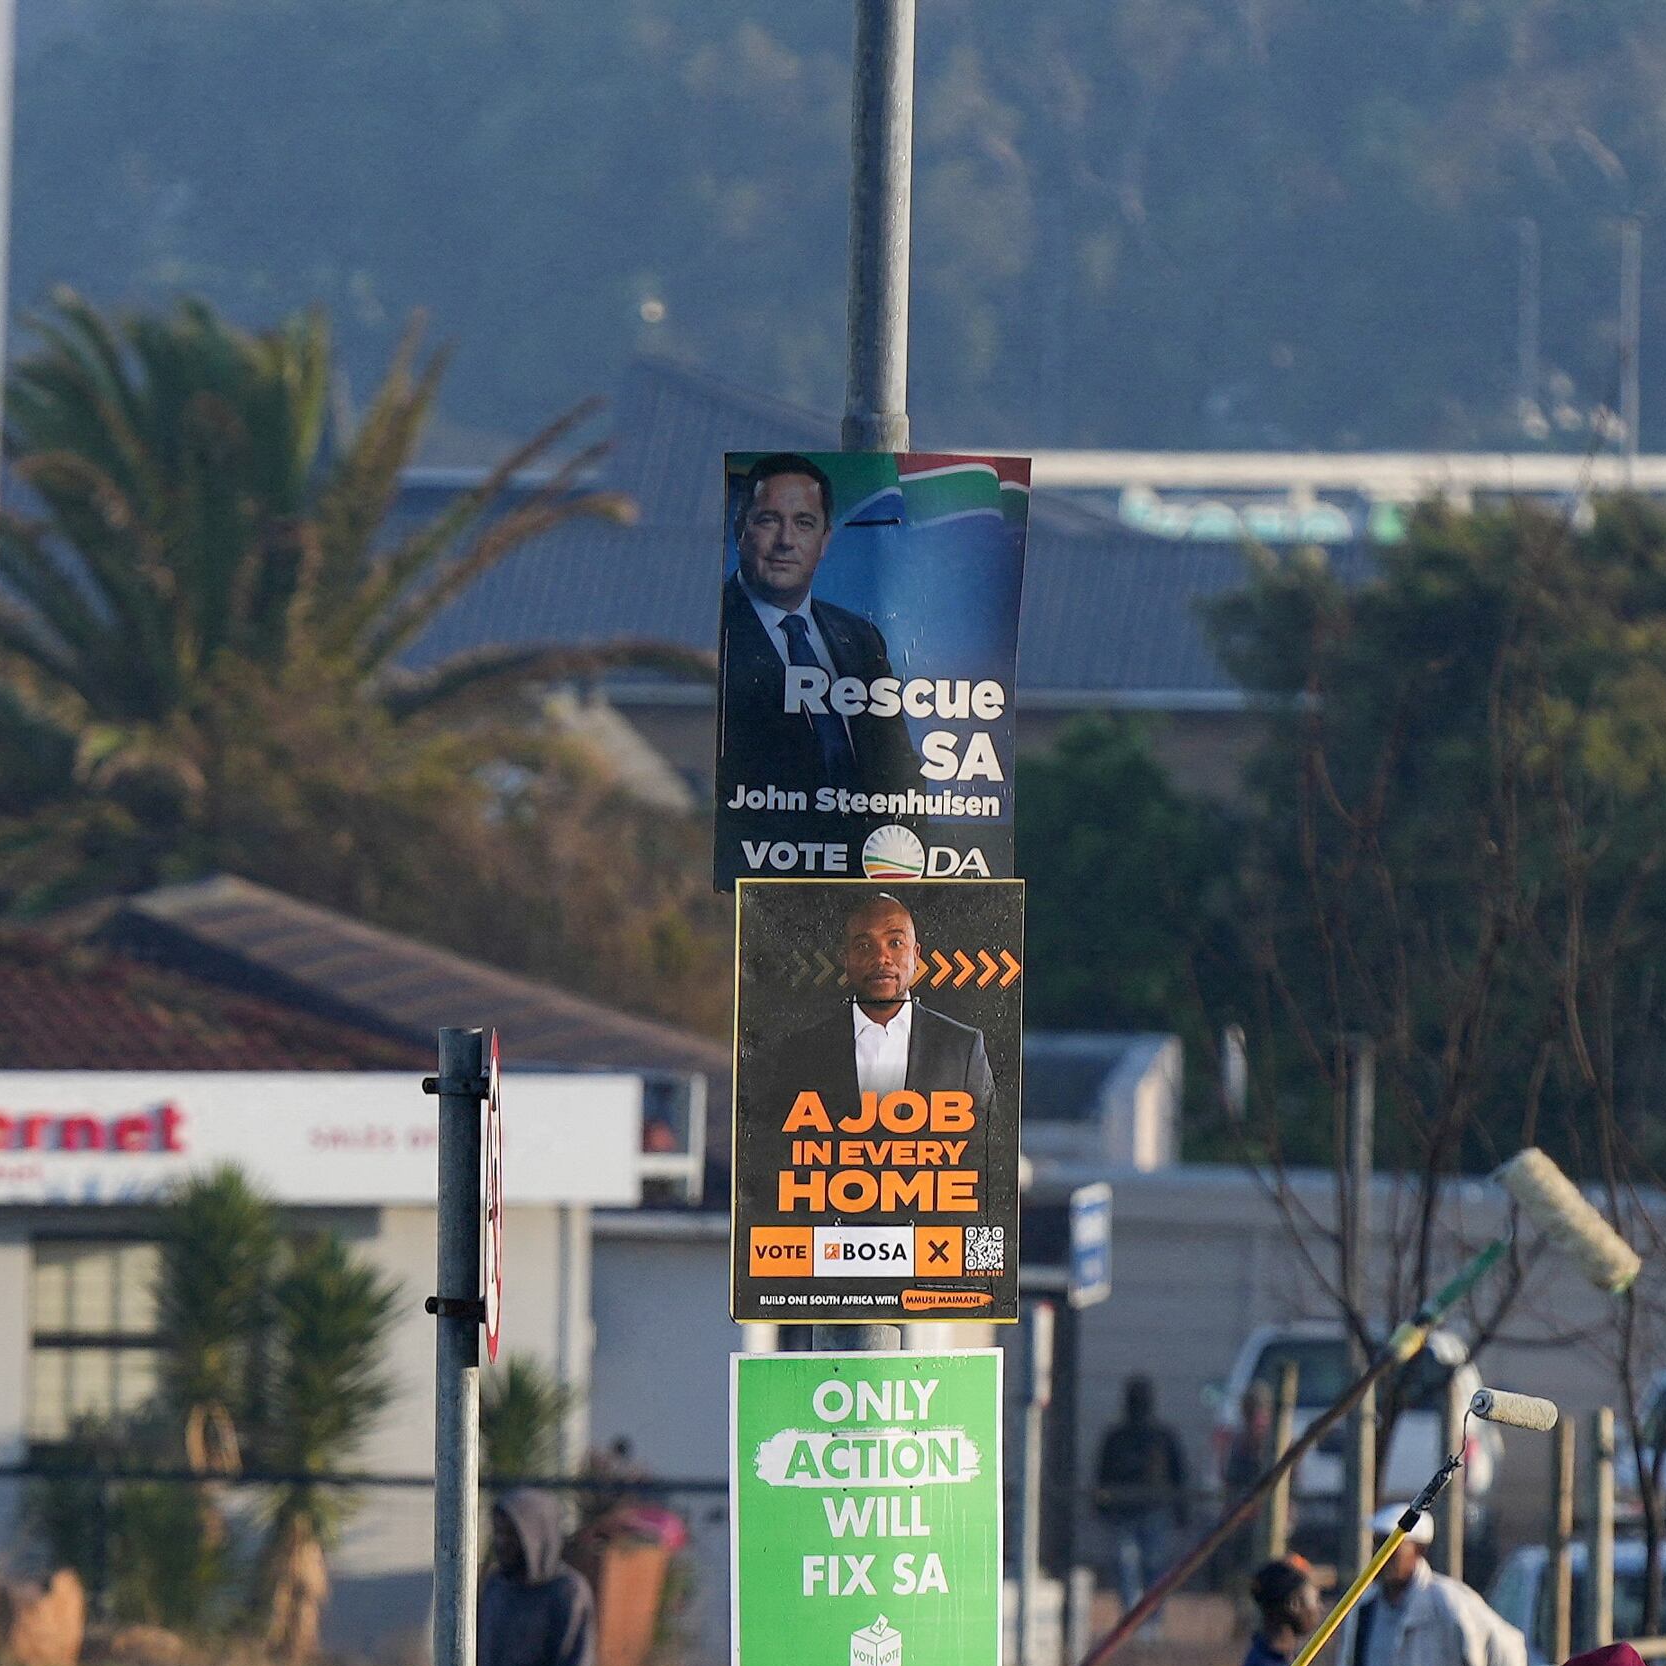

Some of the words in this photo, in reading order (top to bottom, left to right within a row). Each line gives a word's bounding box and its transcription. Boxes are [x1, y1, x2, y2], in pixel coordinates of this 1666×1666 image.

[784, 665, 1005, 720] Rescue
[920, 731, 1004, 782] SA
[727, 784, 807, 811] John
[814, 787, 1000, 817] Steenhuisen
[741, 840, 848, 871] VOTE
[927, 846, 991, 877] DA
[781, 1091, 833, 1132] A
[837, 1090, 976, 1133] JOB
[792, 1140, 832, 1165] IN
[839, 1140, 968, 1165] EVERY
[778, 1170, 979, 1213] HOME
[755, 1245, 807, 1259] VOTE
[843, 1243, 908, 1261] BOSA
[760, 1296, 786, 1305] BUILD
[788, 1296, 808, 1305] ONE
[809, 1295, 840, 1305] SOUTH
[842, 1295, 874, 1305] AFRICA
[875, 1295, 899, 1305] WITH
[938, 1296, 981, 1304] MAIMANE
[813, 1379, 939, 1422] ONLY
[785, 1438, 960, 1480] ACTION
[823, 1496, 931, 1537] WILL
[803, 1554, 878, 1596] FIX
[893, 1553, 950, 1594] SA
[853, 1648, 874, 1666] VOTE
[879, 1648, 900, 1665] VOTE
